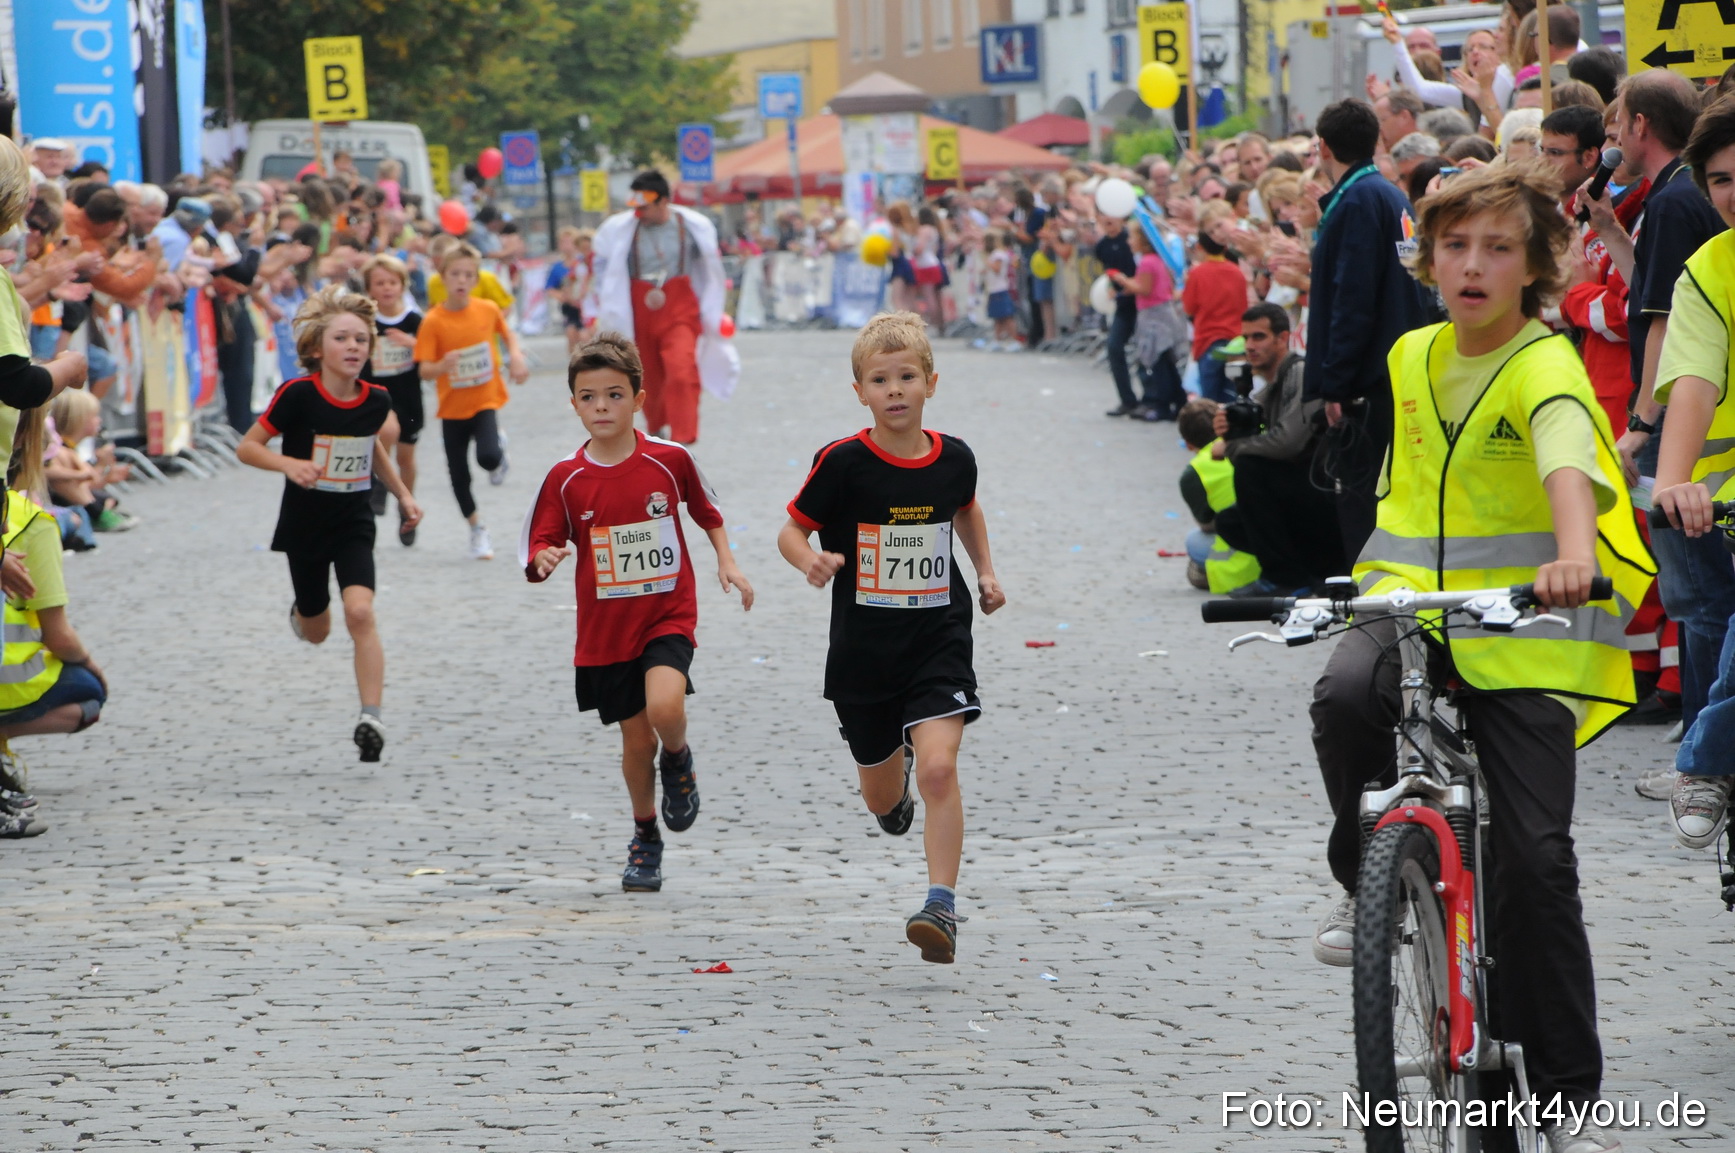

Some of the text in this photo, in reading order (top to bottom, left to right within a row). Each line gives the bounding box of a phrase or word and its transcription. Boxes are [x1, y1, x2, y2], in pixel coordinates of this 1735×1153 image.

[1144, 7, 1185, 23] Block
[1154, 30, 1179, 65] B
[324, 64, 349, 101] B
[935, 142, 954, 167] C
[889, 506, 934, 514] NEUMARKTER
[614, 530, 652, 545] Tobias
[884, 532, 924, 547] Jonas
[596, 554, 608, 565] K4
[618, 546, 674, 573] 7109
[861, 553, 873, 567] K4
[886, 556, 945, 580] 7100
